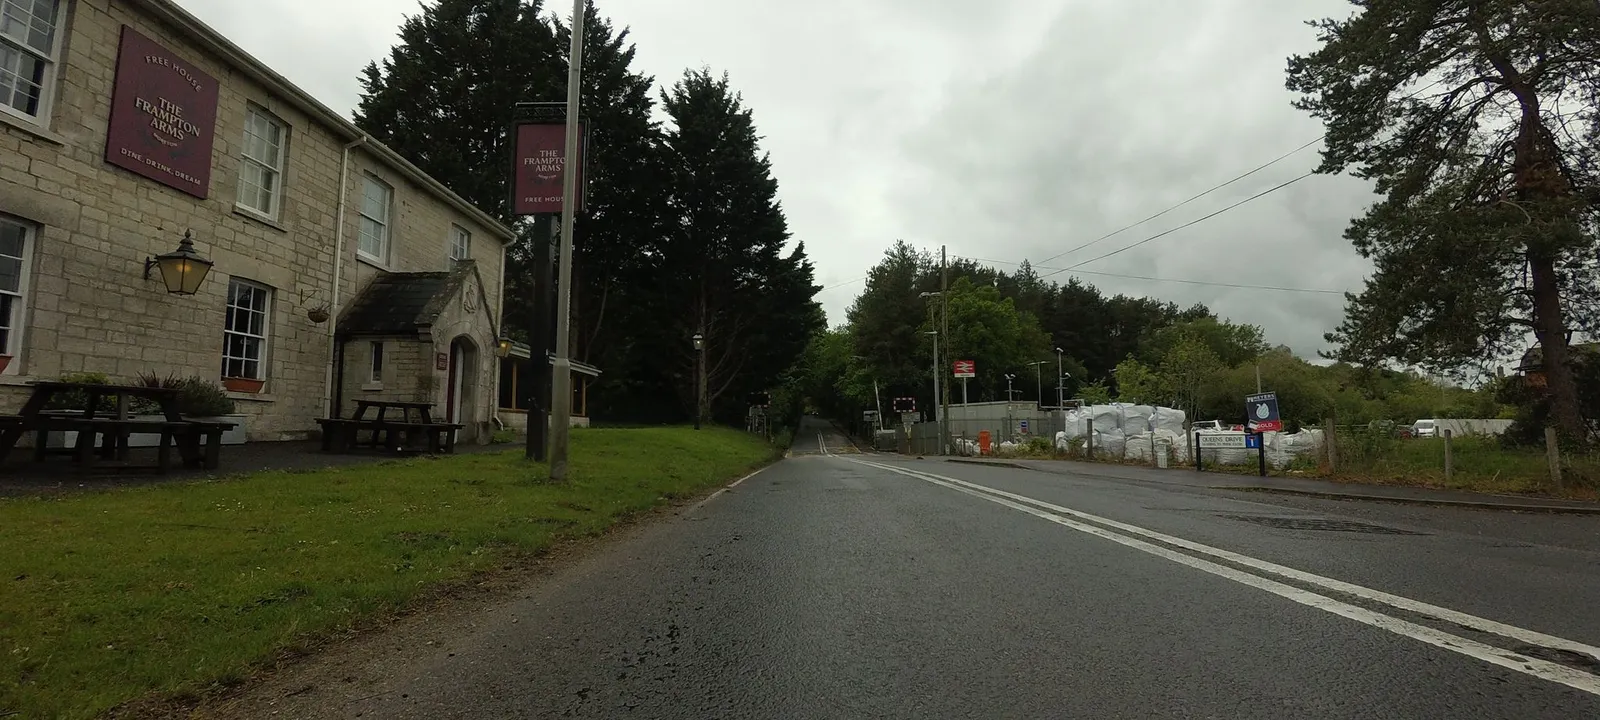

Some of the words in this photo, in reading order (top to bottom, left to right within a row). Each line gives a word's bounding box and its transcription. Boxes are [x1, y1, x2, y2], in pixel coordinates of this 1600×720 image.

[145, 55, 168, 67] FREE
[172, 63, 202, 92] HOUSE
[135, 97, 200, 137] FRAMPTON
[159, 96, 182, 117] THE
[150, 118, 184, 141] ARMS
[524, 157, 567, 165] FRAMPTO
[536, 164, 561, 172] ARMS
[175, 170, 201, 186] DREAM
